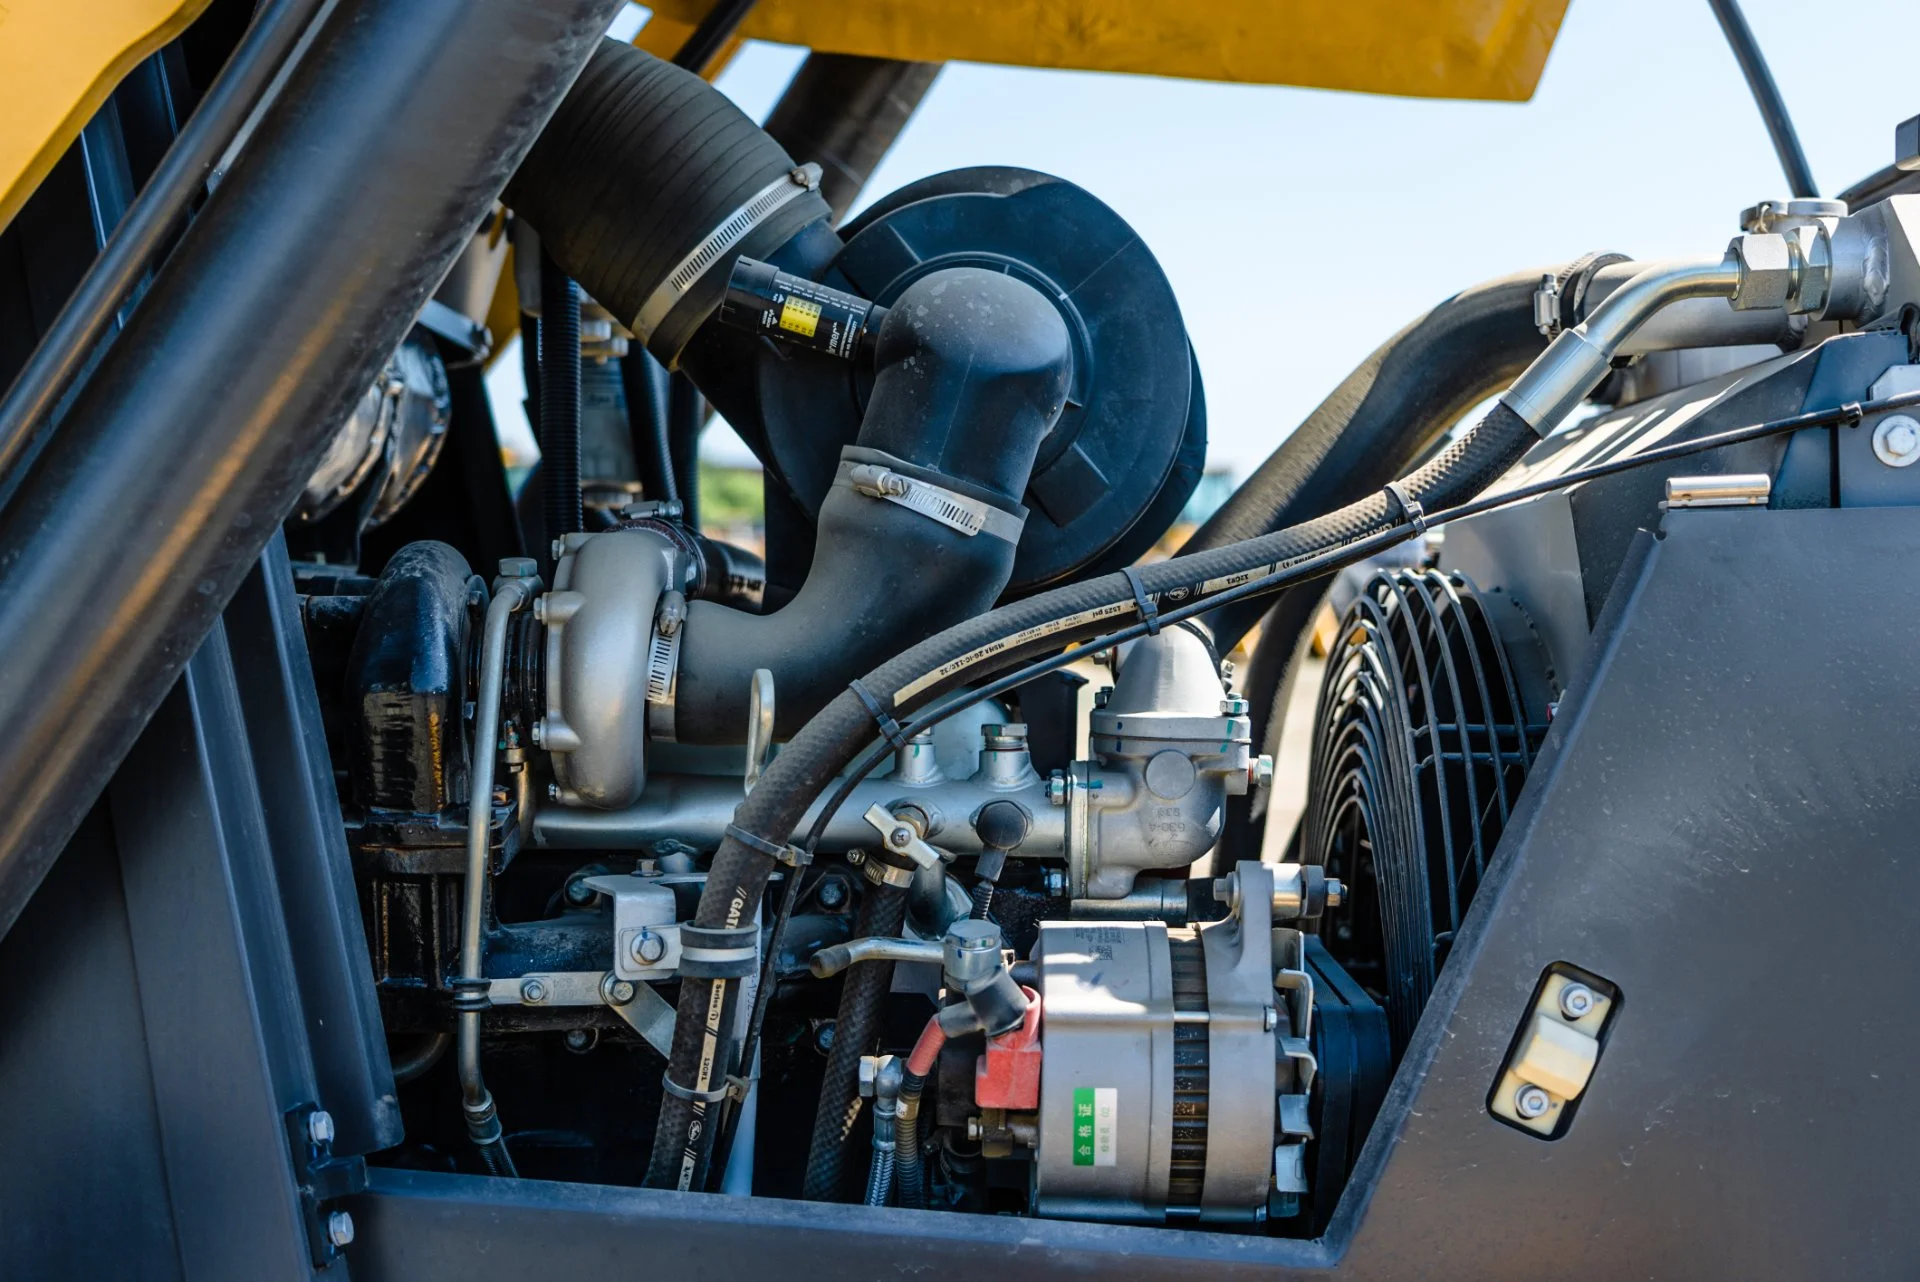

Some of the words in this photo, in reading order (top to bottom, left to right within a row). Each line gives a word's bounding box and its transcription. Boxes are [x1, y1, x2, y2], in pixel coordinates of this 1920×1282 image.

[1092, 610, 1103, 618] psi
[1104, 605, 1122, 615] 1525
[711, 984, 722, 1009] Series
[1078, 1103, 1092, 1156] 合格证
